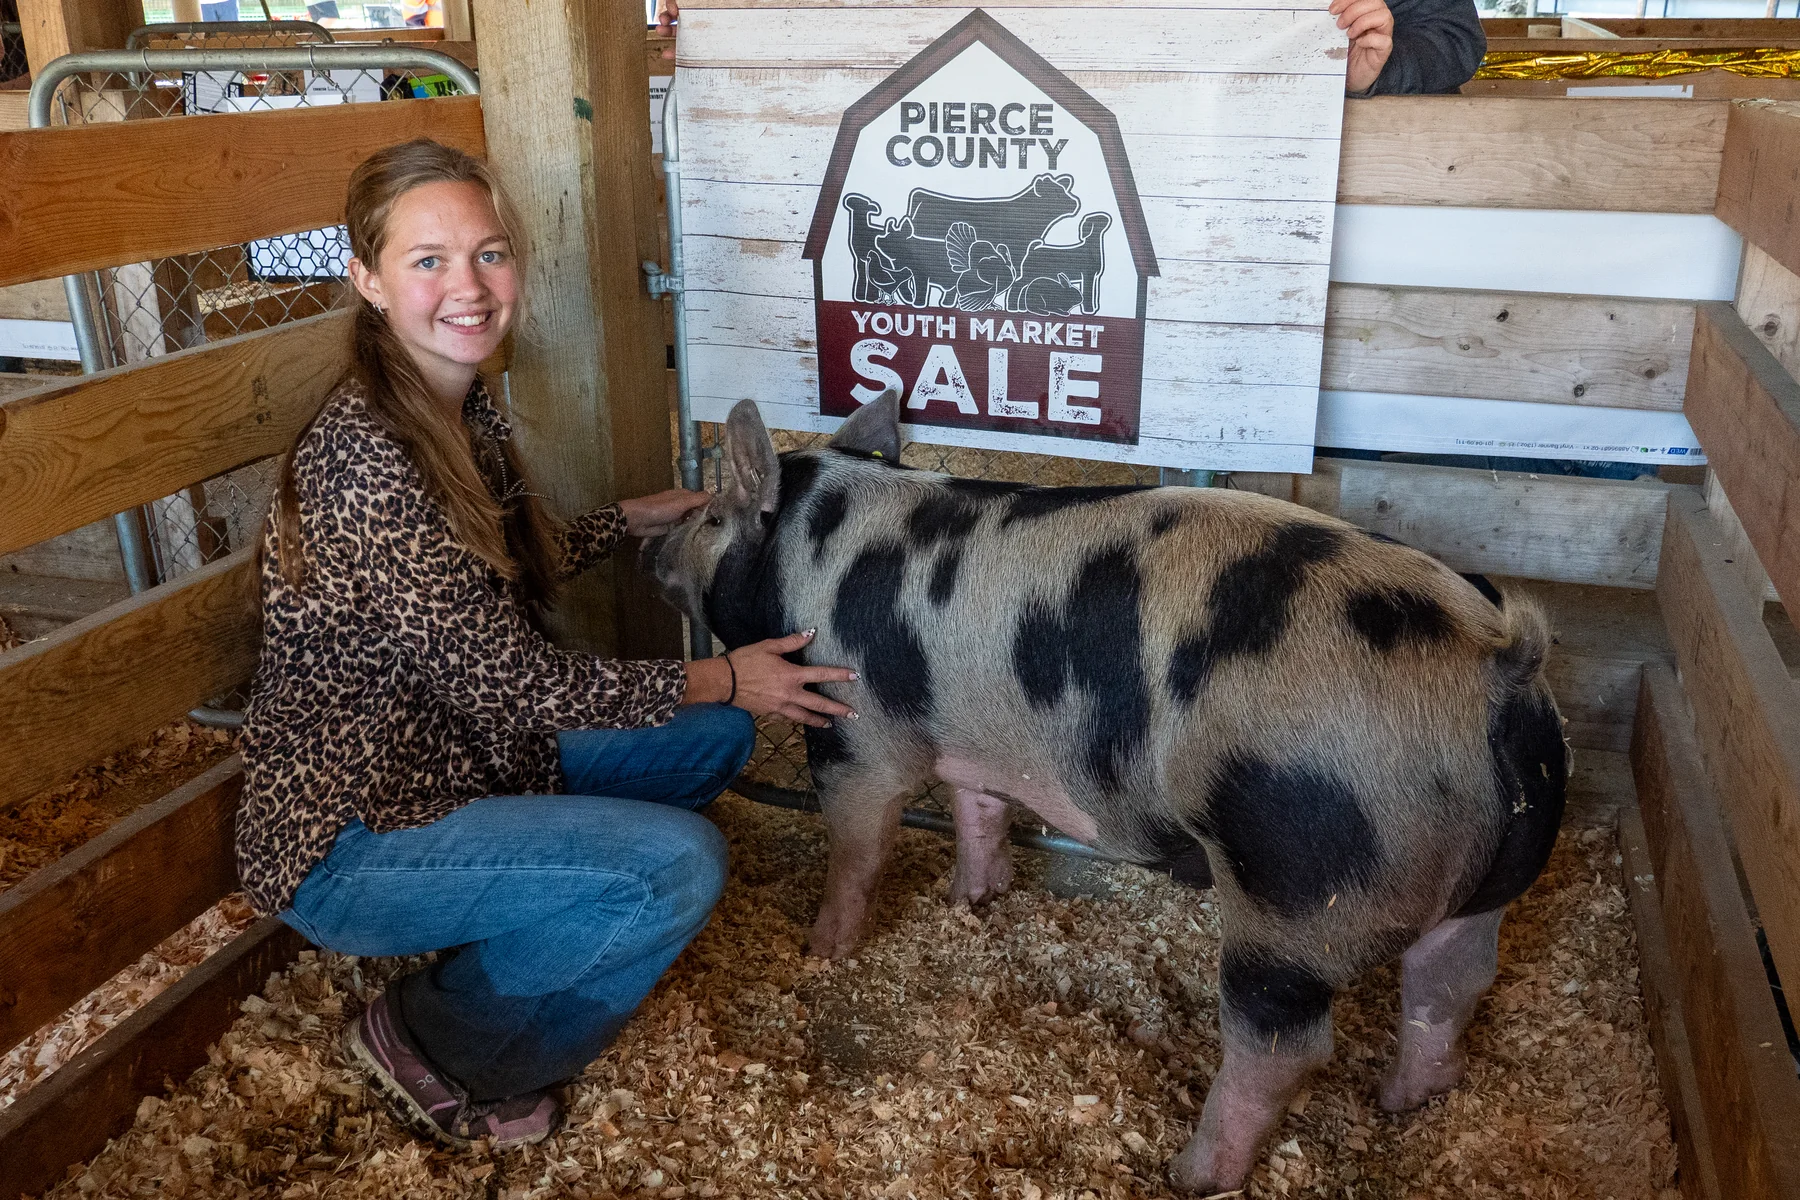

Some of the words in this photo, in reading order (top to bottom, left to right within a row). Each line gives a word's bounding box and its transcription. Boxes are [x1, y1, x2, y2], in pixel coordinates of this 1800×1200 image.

[900, 101, 1054, 136] PIERCE
[885, 136, 1069, 170] COUNTY
[851, 311, 956, 340] YOUTH
[970, 317, 1105, 348] MARKET
[850, 338, 1103, 425] SALE
